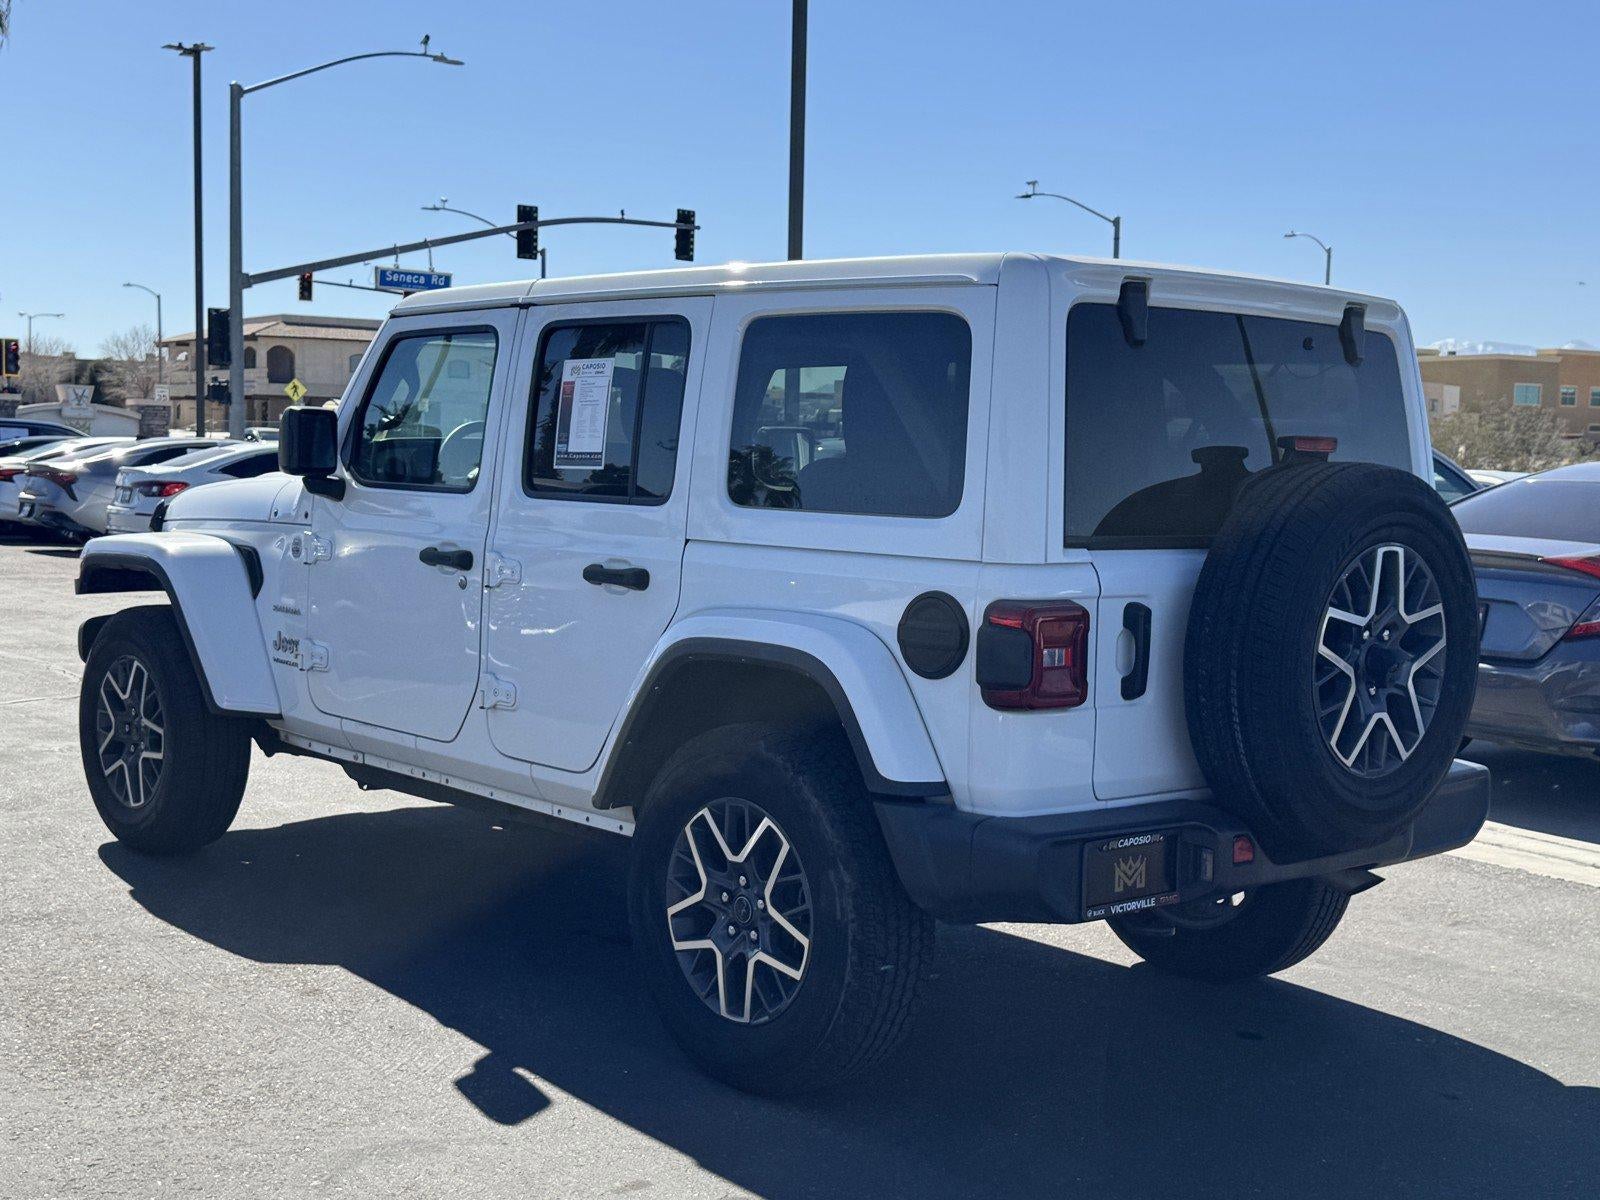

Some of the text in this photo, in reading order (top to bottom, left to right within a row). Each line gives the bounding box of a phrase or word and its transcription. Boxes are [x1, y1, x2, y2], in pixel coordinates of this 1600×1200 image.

[386, 270, 445, 286] Seneca Rd
[582, 362, 606, 370] CAPOSIO
[273, 630, 300, 653] Jeep
[1117, 834, 1151, 848] CAPOSIO
[1110, 897, 1155, 914] VICTORVILLE
